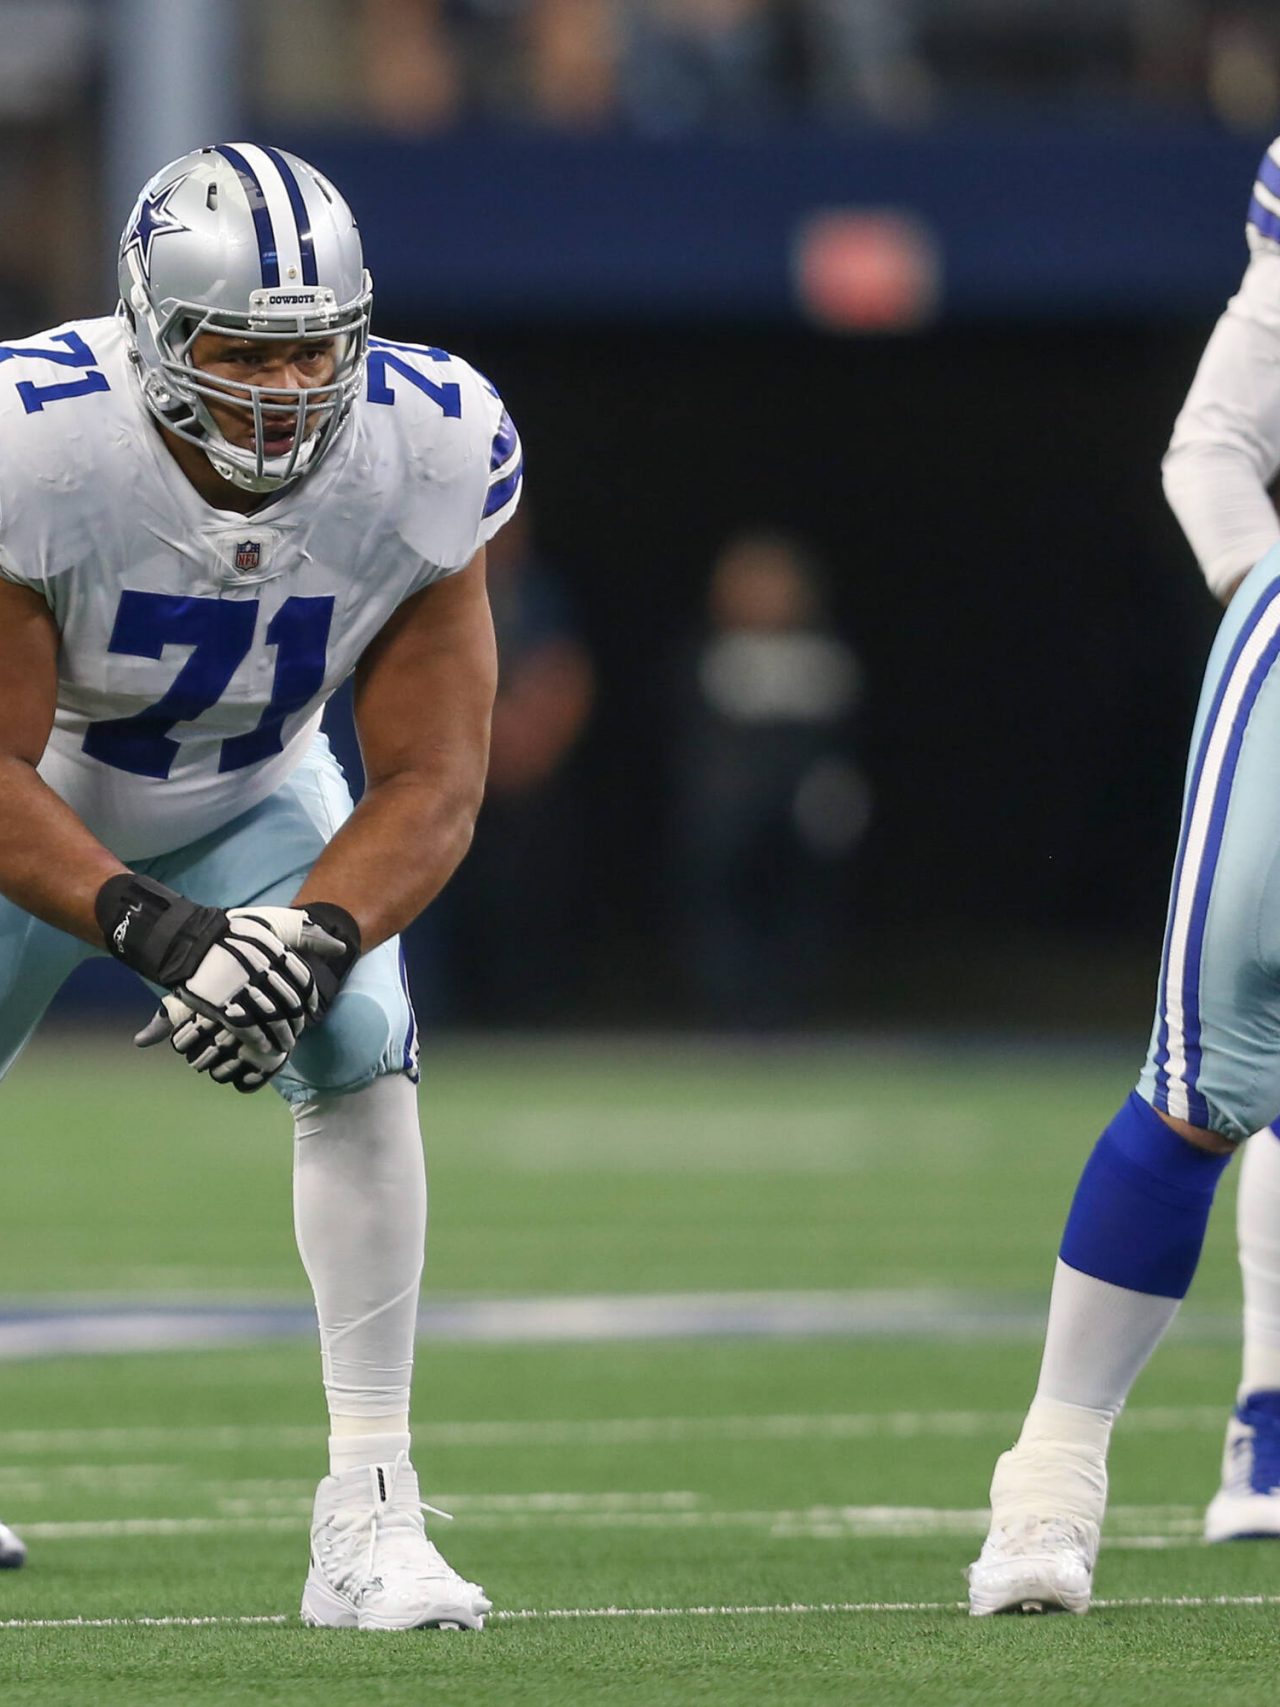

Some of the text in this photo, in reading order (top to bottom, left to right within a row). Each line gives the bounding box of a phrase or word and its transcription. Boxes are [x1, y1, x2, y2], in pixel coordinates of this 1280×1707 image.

[269, 294, 316, 305] COWBOYS
[238, 552, 258, 567] NFL
[81, 590, 335, 780] 71
